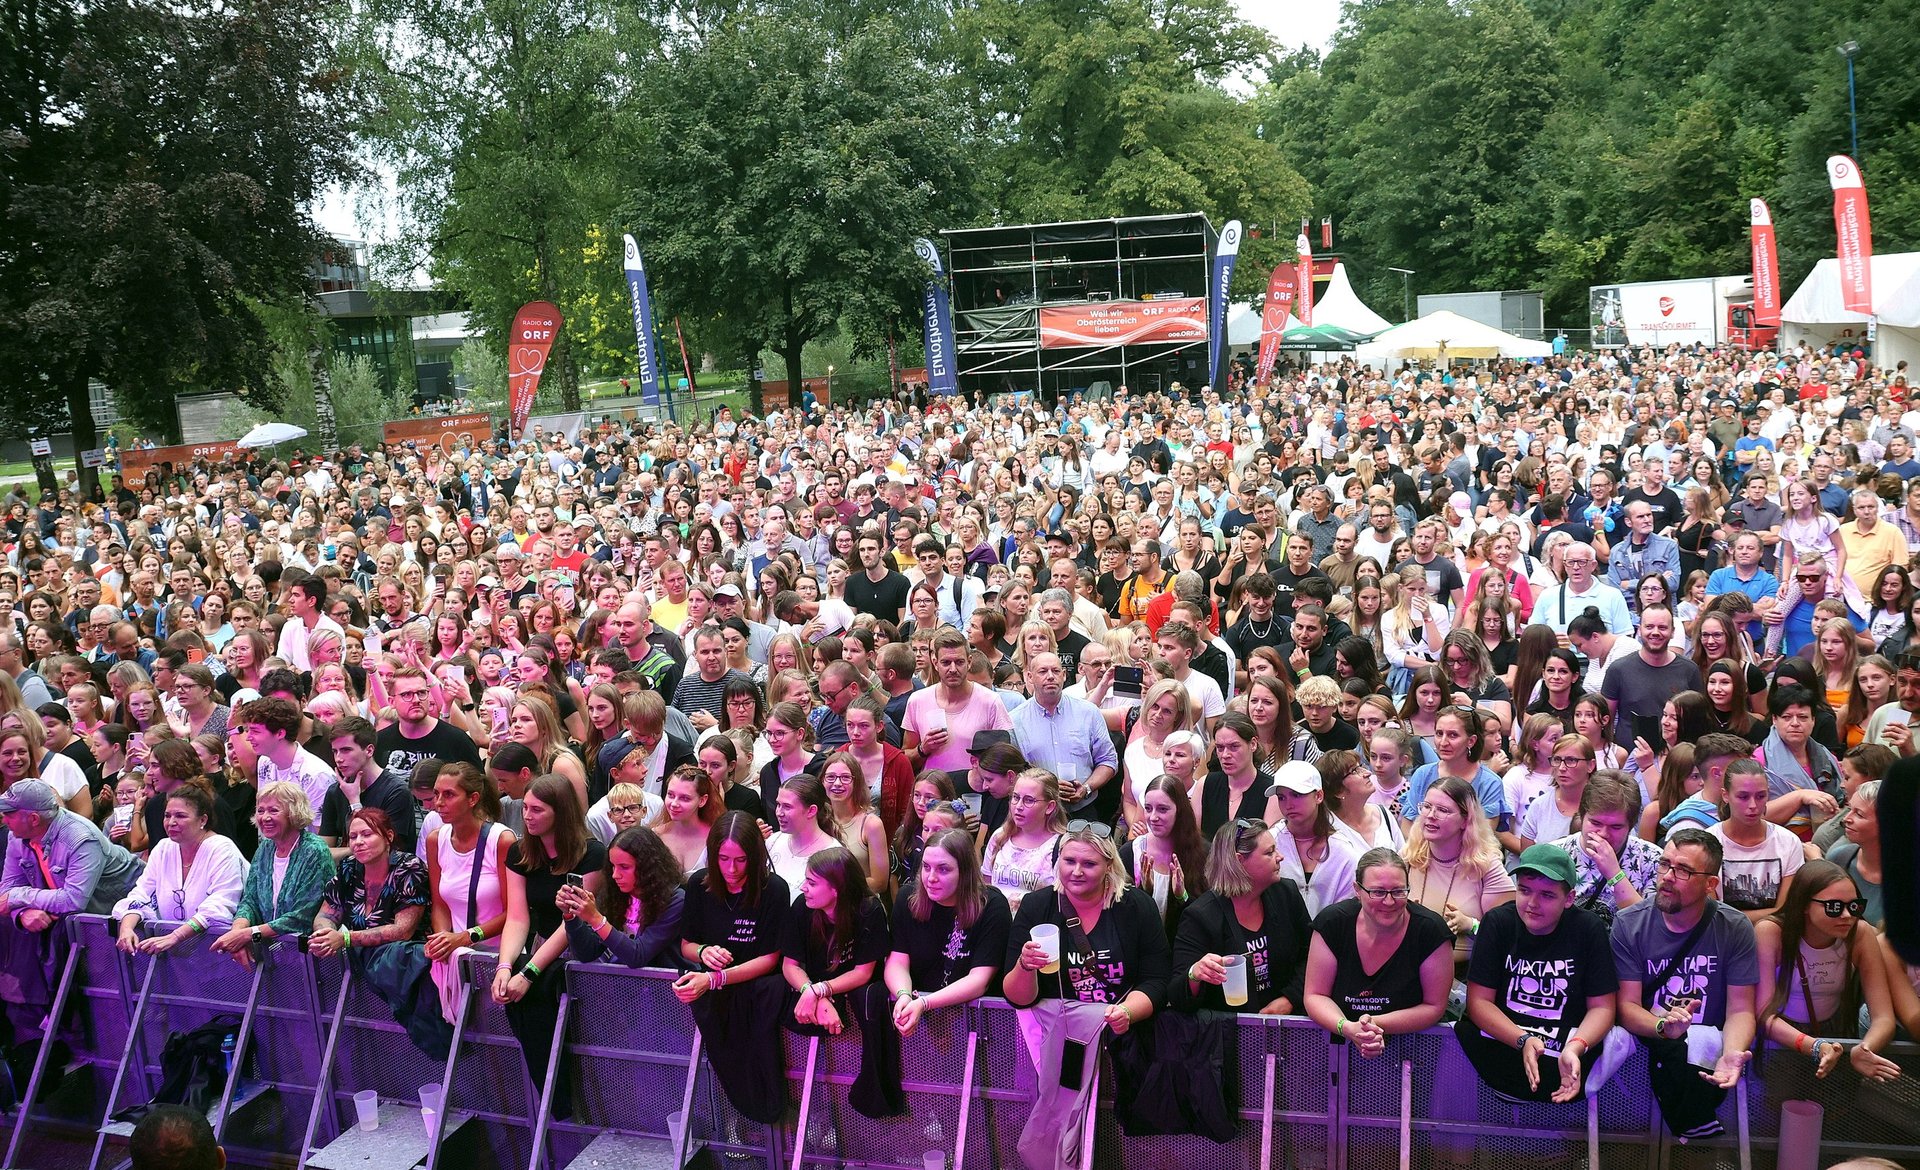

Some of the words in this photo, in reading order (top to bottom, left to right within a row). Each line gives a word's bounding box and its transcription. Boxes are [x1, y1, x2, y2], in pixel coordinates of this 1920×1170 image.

[1274, 292, 1291, 300] ORF
[1090, 310, 1108, 318] Weil
[1077, 318, 1137, 327] Oberösterreich
[523, 331, 550, 340] ORF
[441, 419, 460, 427] ORF
[194, 447, 216, 455] ORF
[1505, 954, 1575, 977] MIXTAPE
[1345, 996, 1390, 1004] EVERYBODY'S
